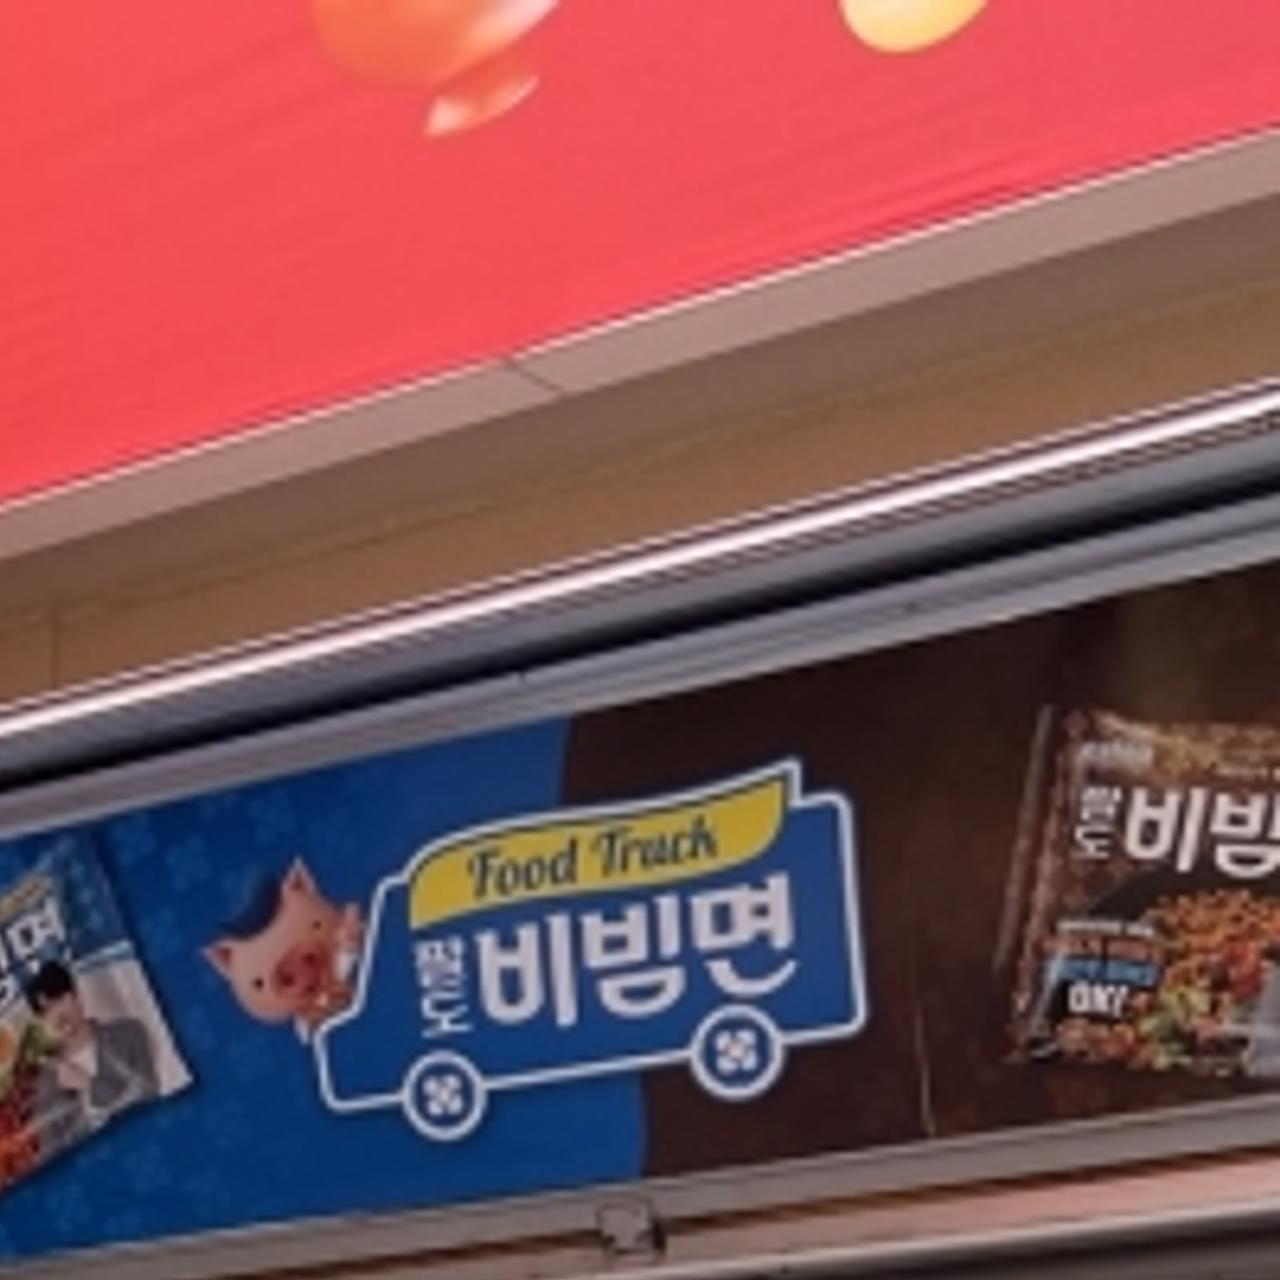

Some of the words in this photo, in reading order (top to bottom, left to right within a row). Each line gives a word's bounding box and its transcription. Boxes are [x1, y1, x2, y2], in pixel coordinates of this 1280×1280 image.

[468, 837, 578, 899] Food
[591, 815, 719, 876] Truck
[474, 871, 798, 1029] 비빔면
